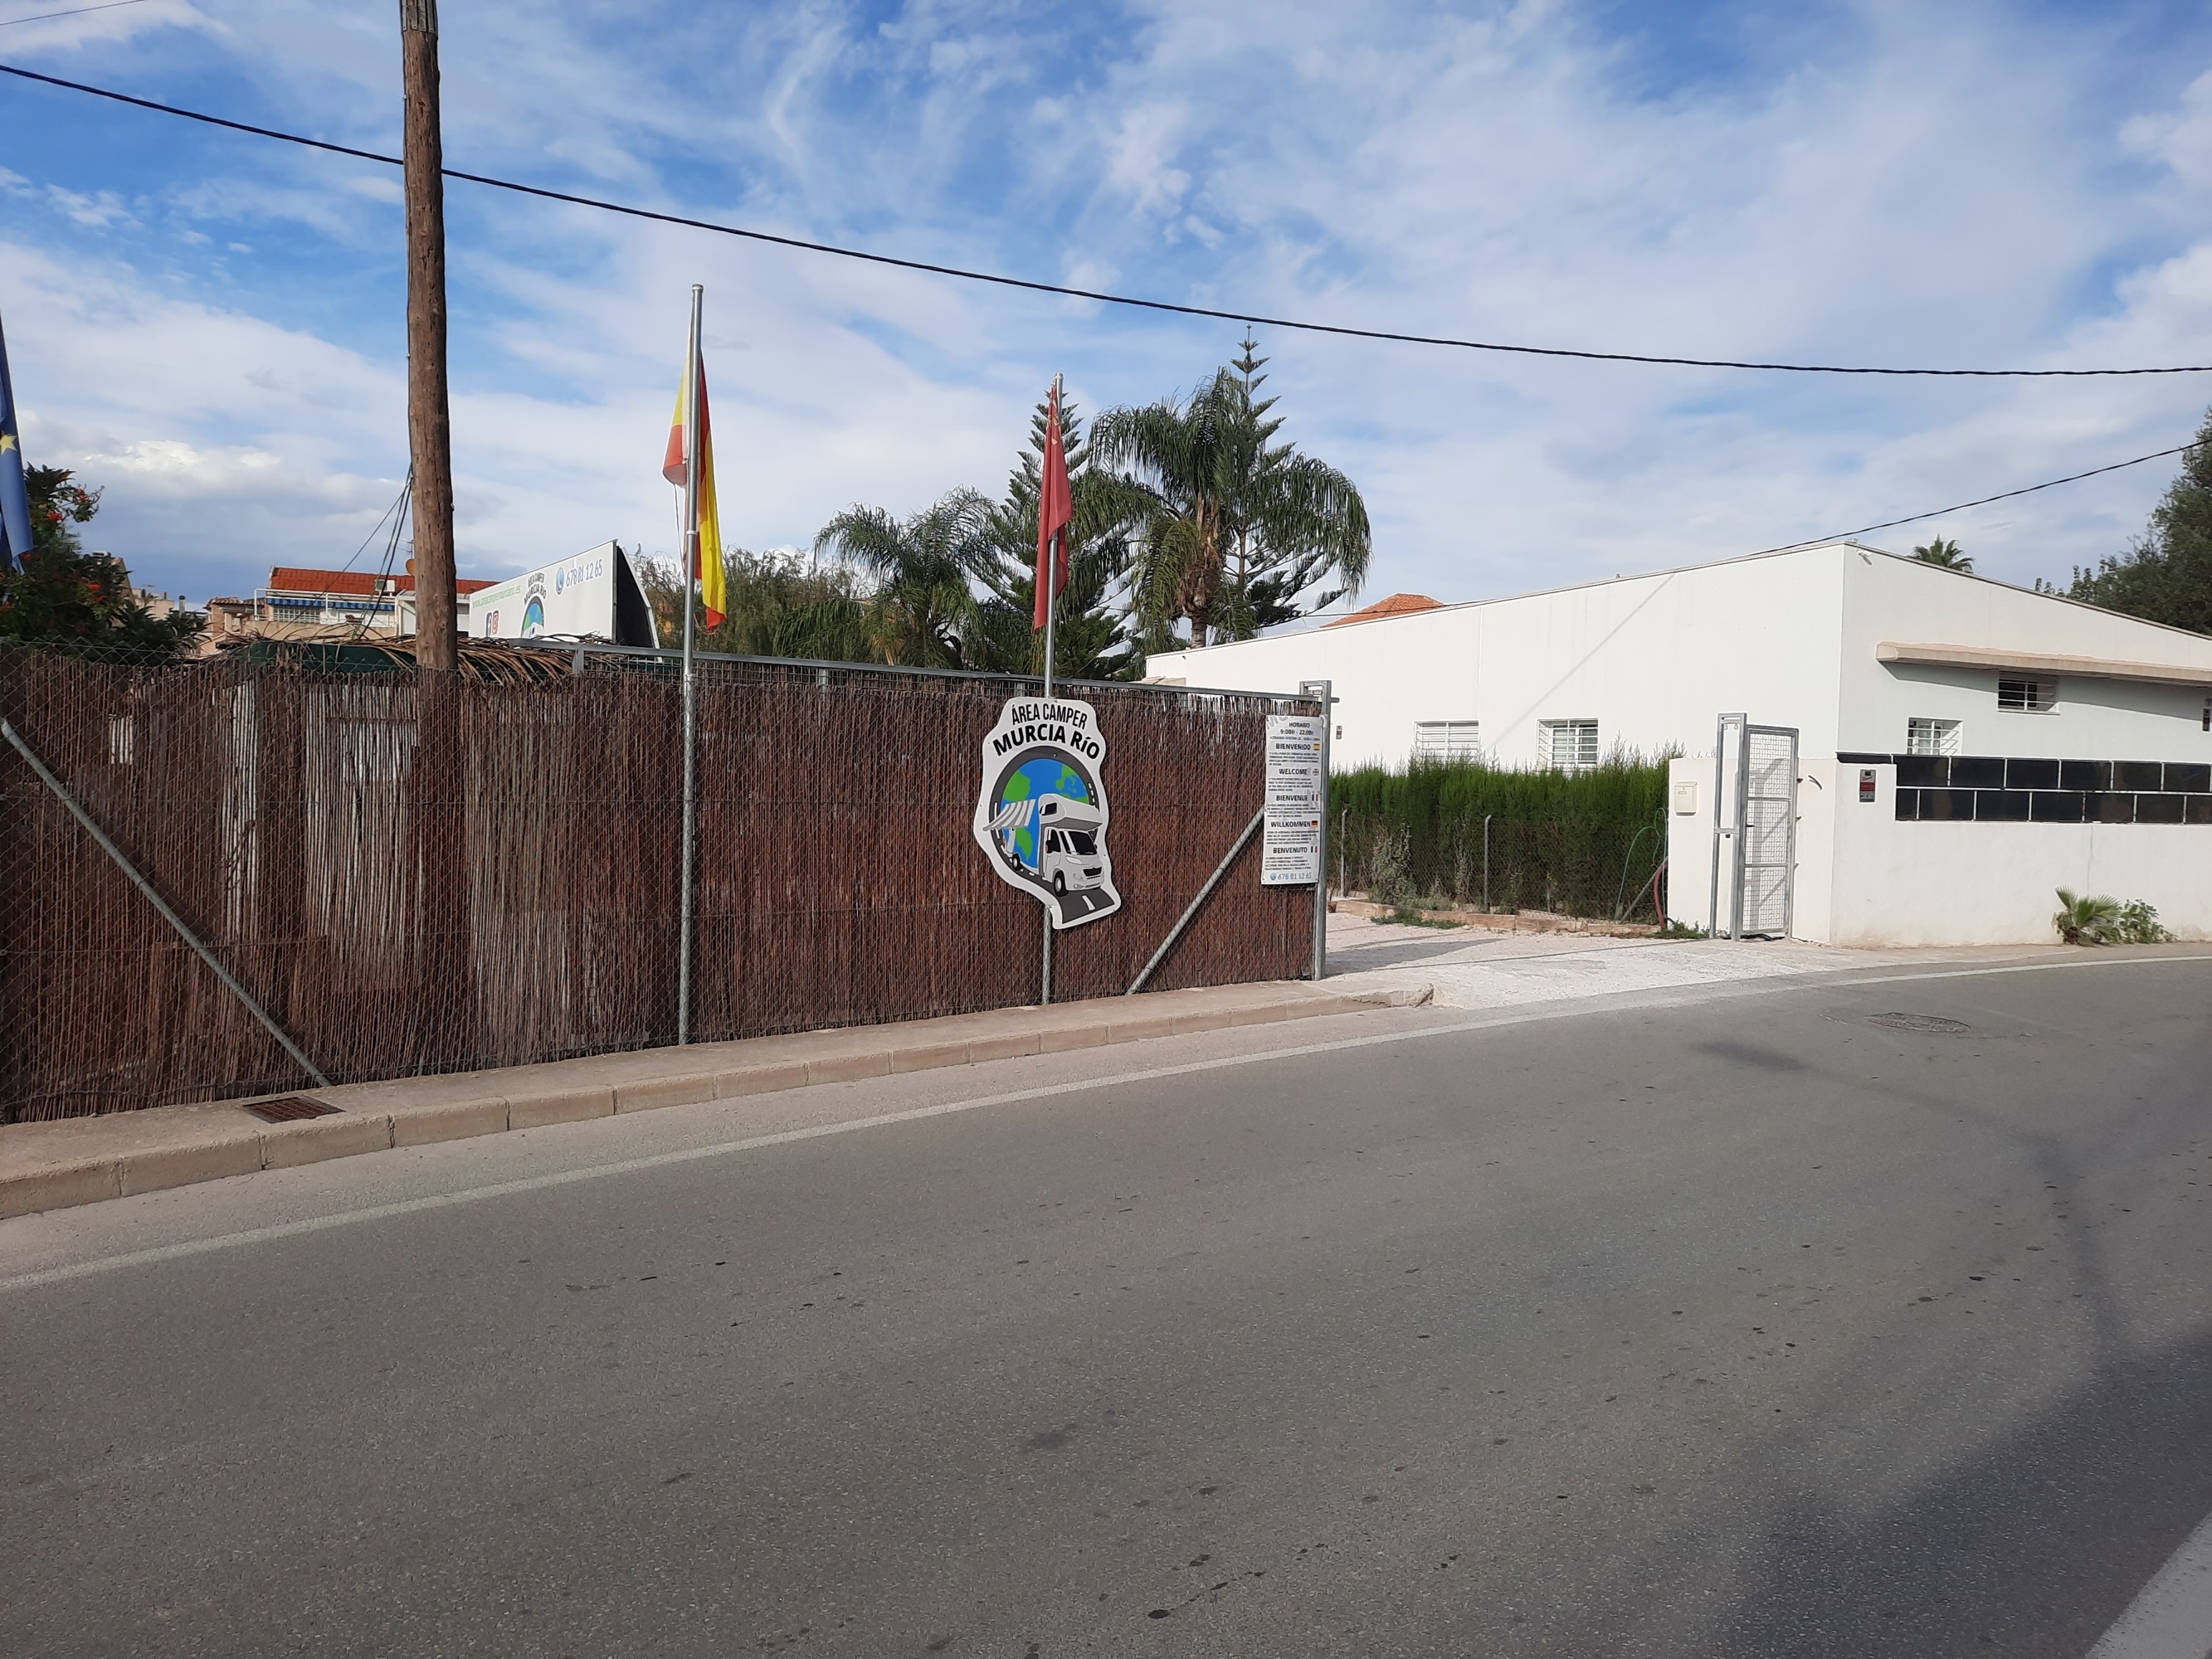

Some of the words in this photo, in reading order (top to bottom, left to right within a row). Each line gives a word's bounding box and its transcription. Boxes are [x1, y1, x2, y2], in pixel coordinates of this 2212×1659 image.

[566, 569, 577, 587] 678
[577, 566, 583, 583] 81
[586, 562, 593, 581] 12
[594, 558, 603, 577] 65
[524, 583, 540, 606] MURCIA
[1011, 703, 1040, 726] ÁREA
[1042, 703, 1088, 730] CAMPER
[992, 723, 1066, 757] MURCIA
[1069, 730, 1100, 760] RÍO
[1275, 742, 1311, 751] BIENVENIDO
